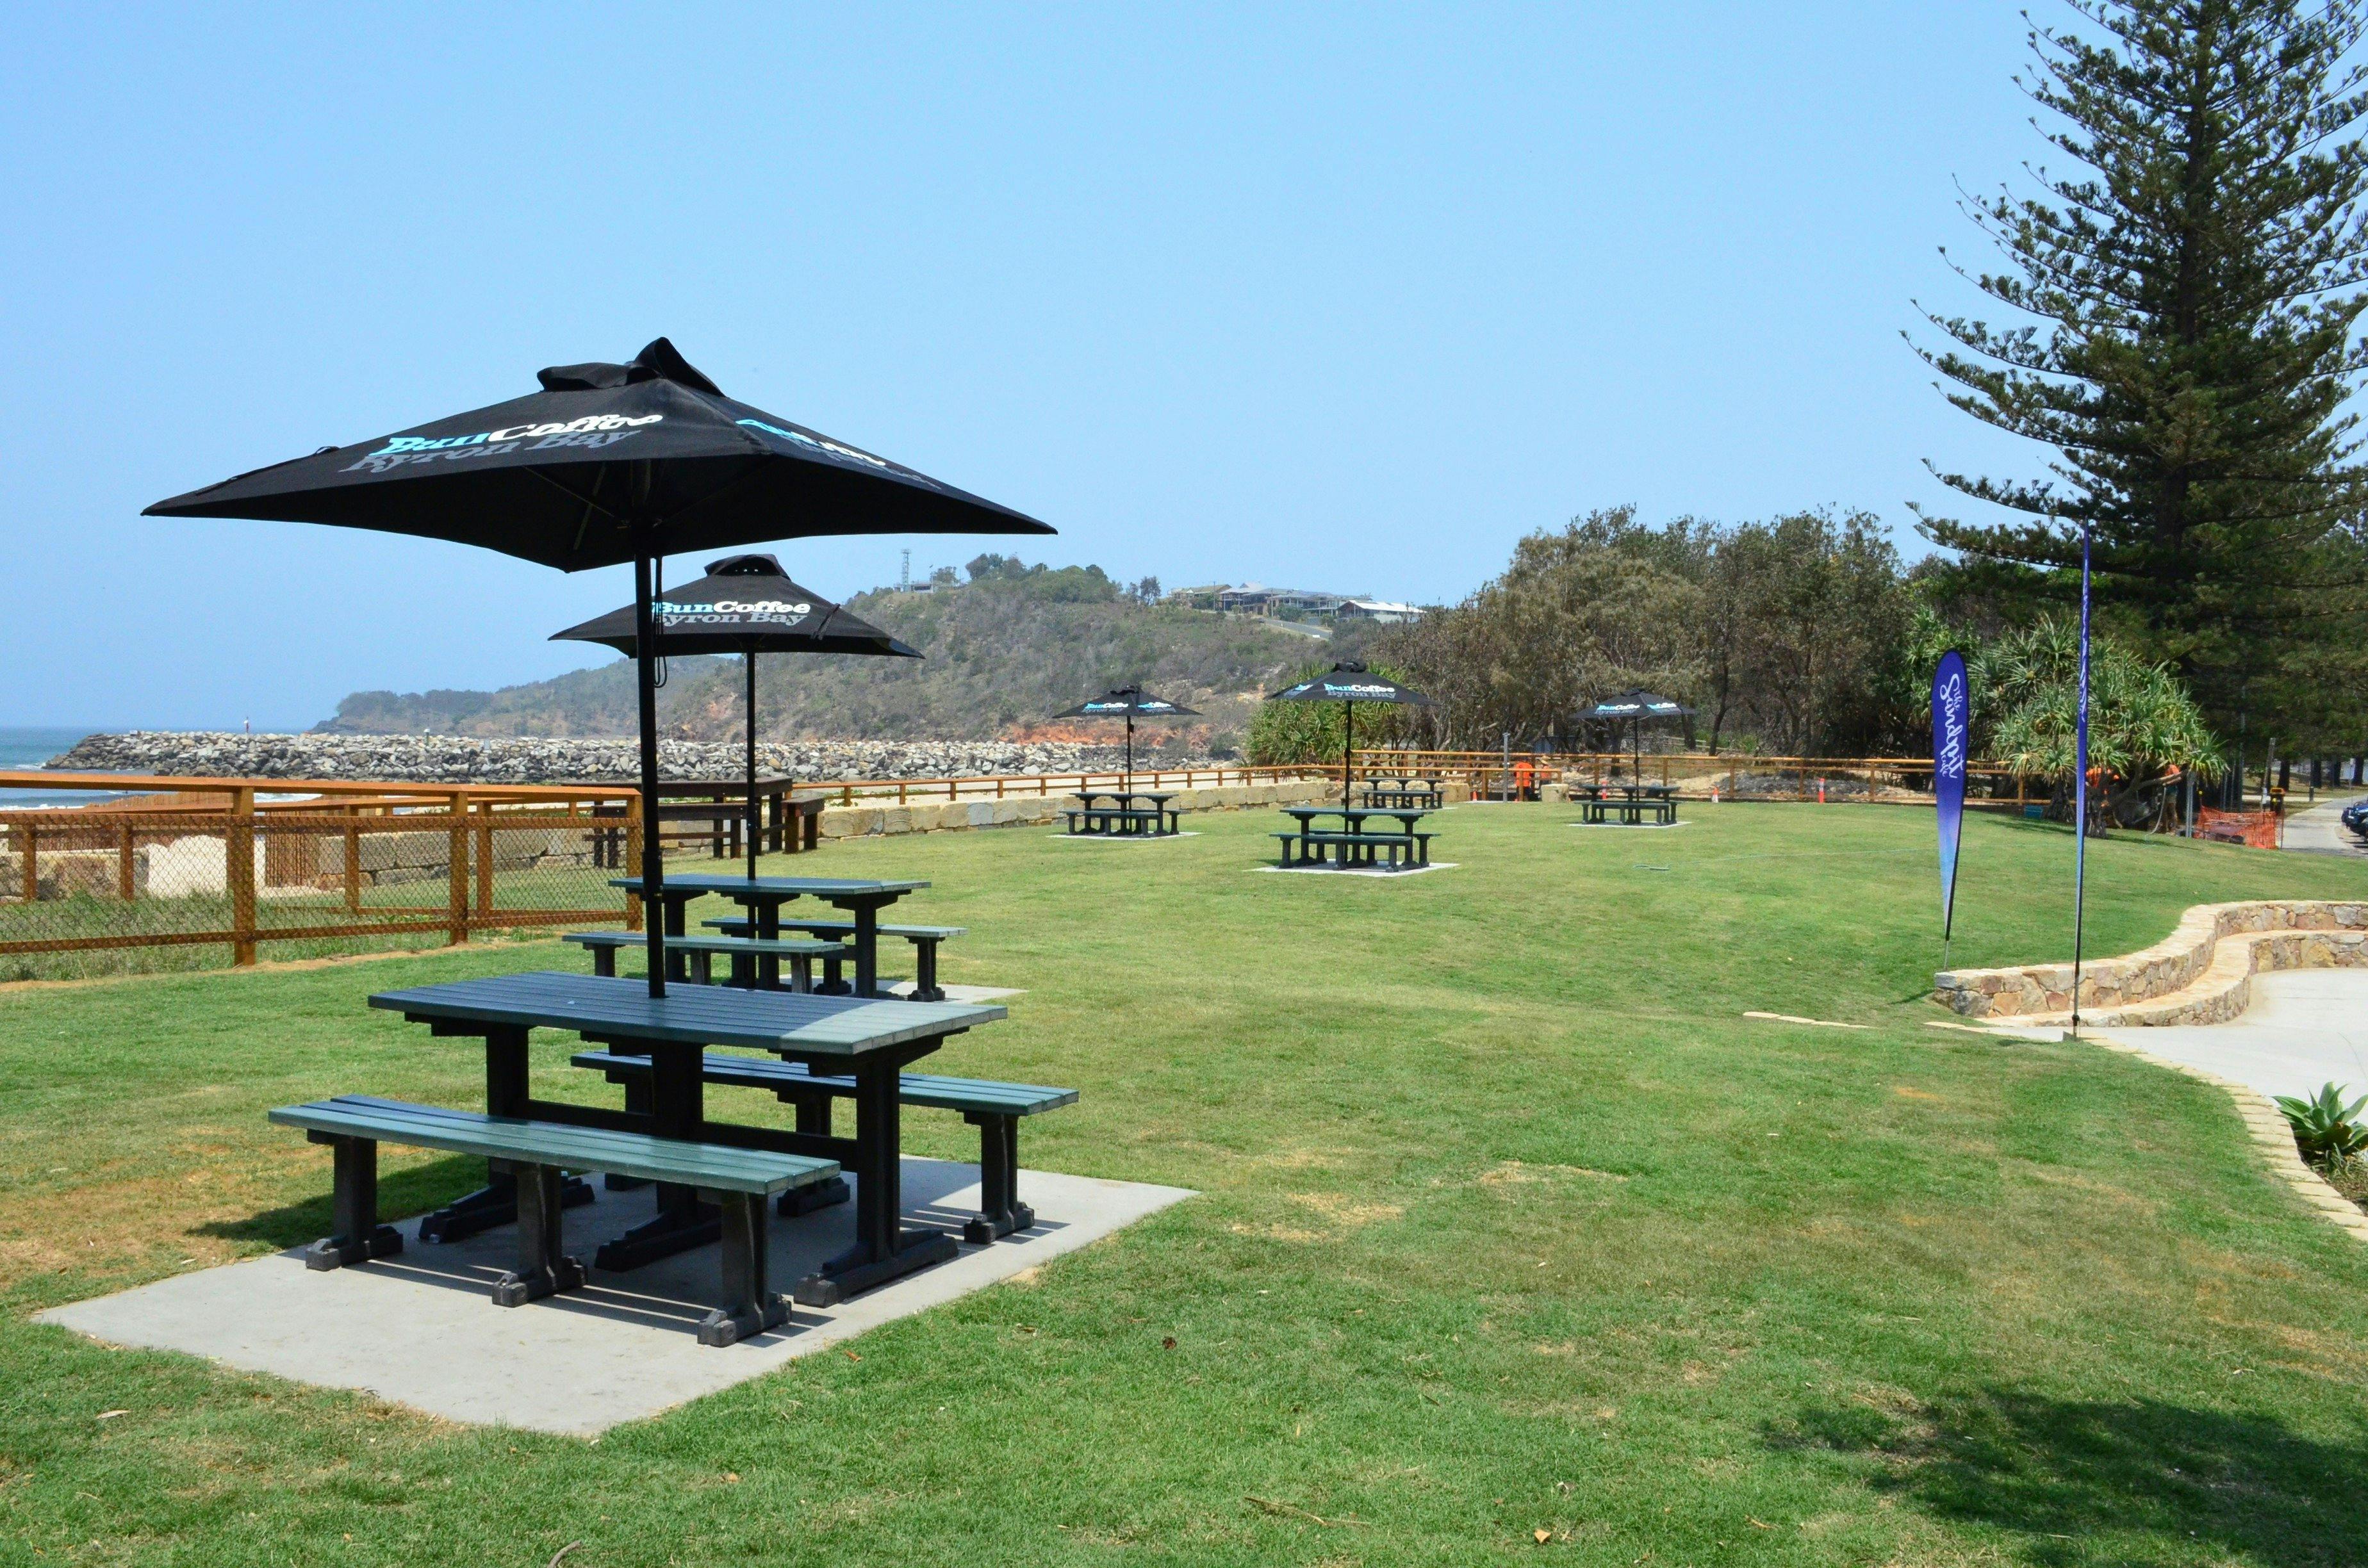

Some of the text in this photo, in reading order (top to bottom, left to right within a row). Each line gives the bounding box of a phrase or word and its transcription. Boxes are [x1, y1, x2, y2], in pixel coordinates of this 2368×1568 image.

[368, 414, 663, 455] BunCoffee
[338, 430, 643, 473] Byron Bay
[652, 601, 811, 614] BunCoffee
[746, 611, 807, 626] Bay
[1324, 683, 1395, 692] BunCoffee
[1939, 673, 1964, 779] Sandpit
